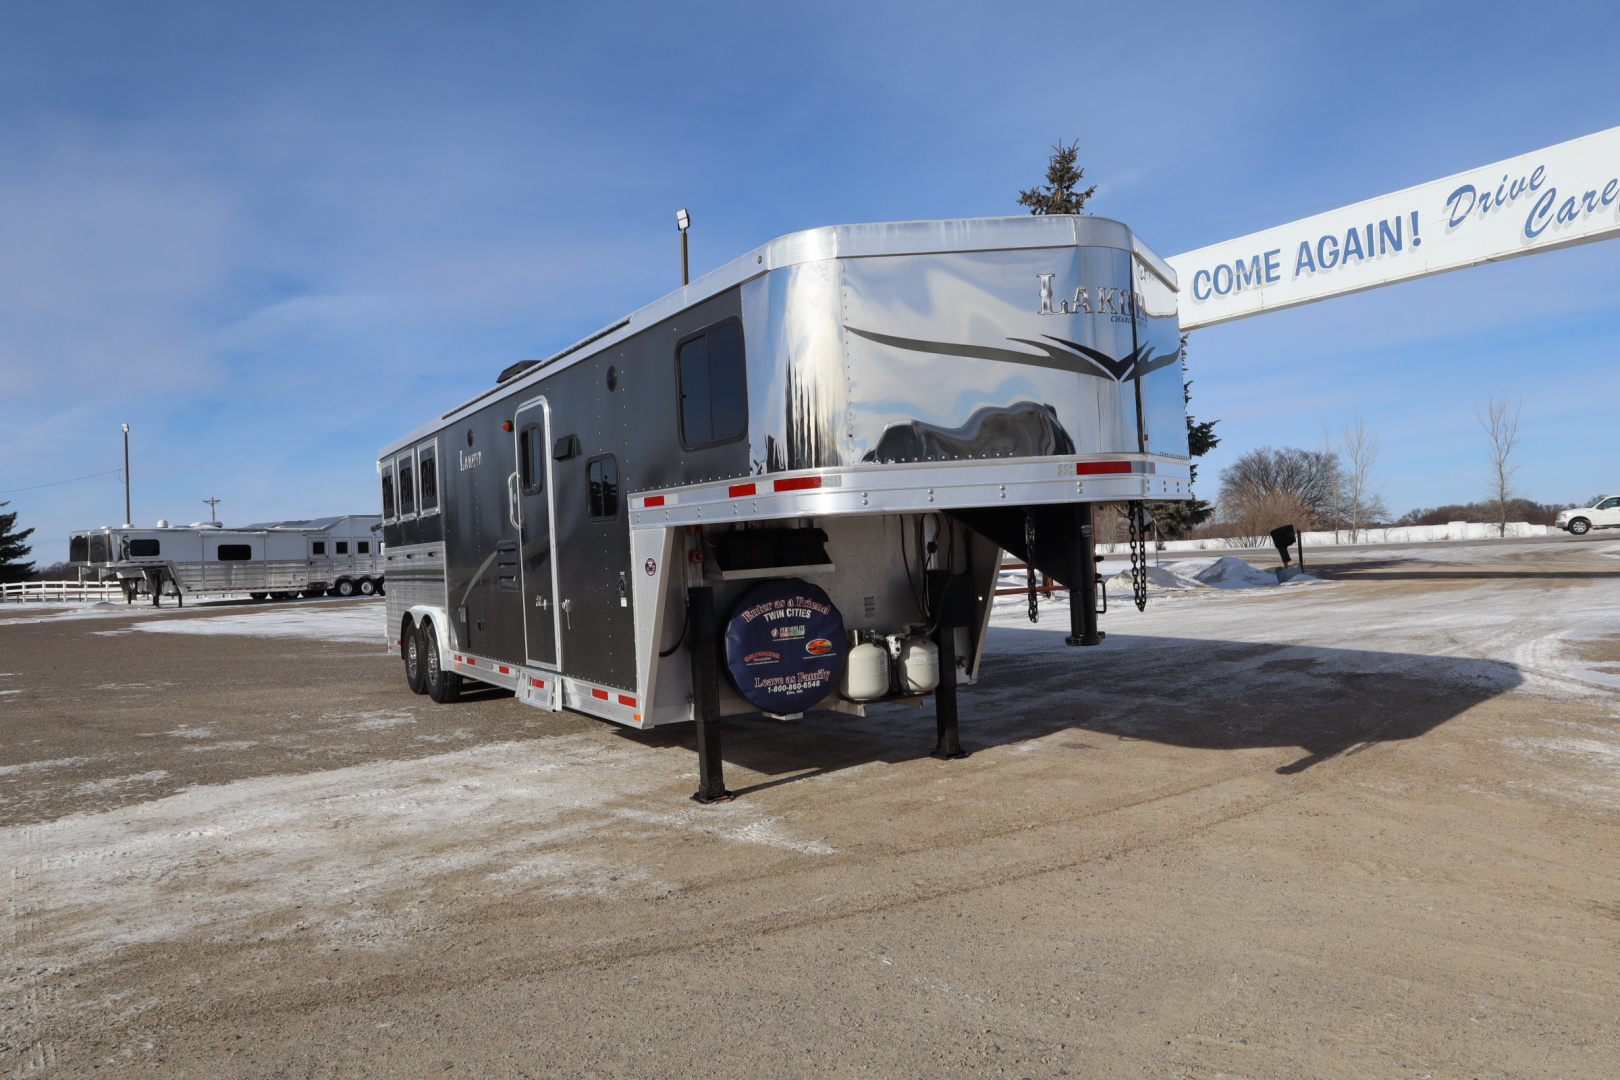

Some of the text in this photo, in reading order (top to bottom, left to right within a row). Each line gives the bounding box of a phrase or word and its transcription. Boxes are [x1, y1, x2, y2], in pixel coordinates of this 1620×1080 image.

[1446, 165, 1547, 229] Drive
[1524, 177, 1620, 239] Care
[1193, 211, 1422, 301] COME AGAIN!
[741, 596, 831, 623] Enter as a Friend
[763, 607, 812, 622] TWIN CITIES
[754, 668, 831, 688] Leave as Family
[767, 680, 820, 694] 1-800-860-6548
